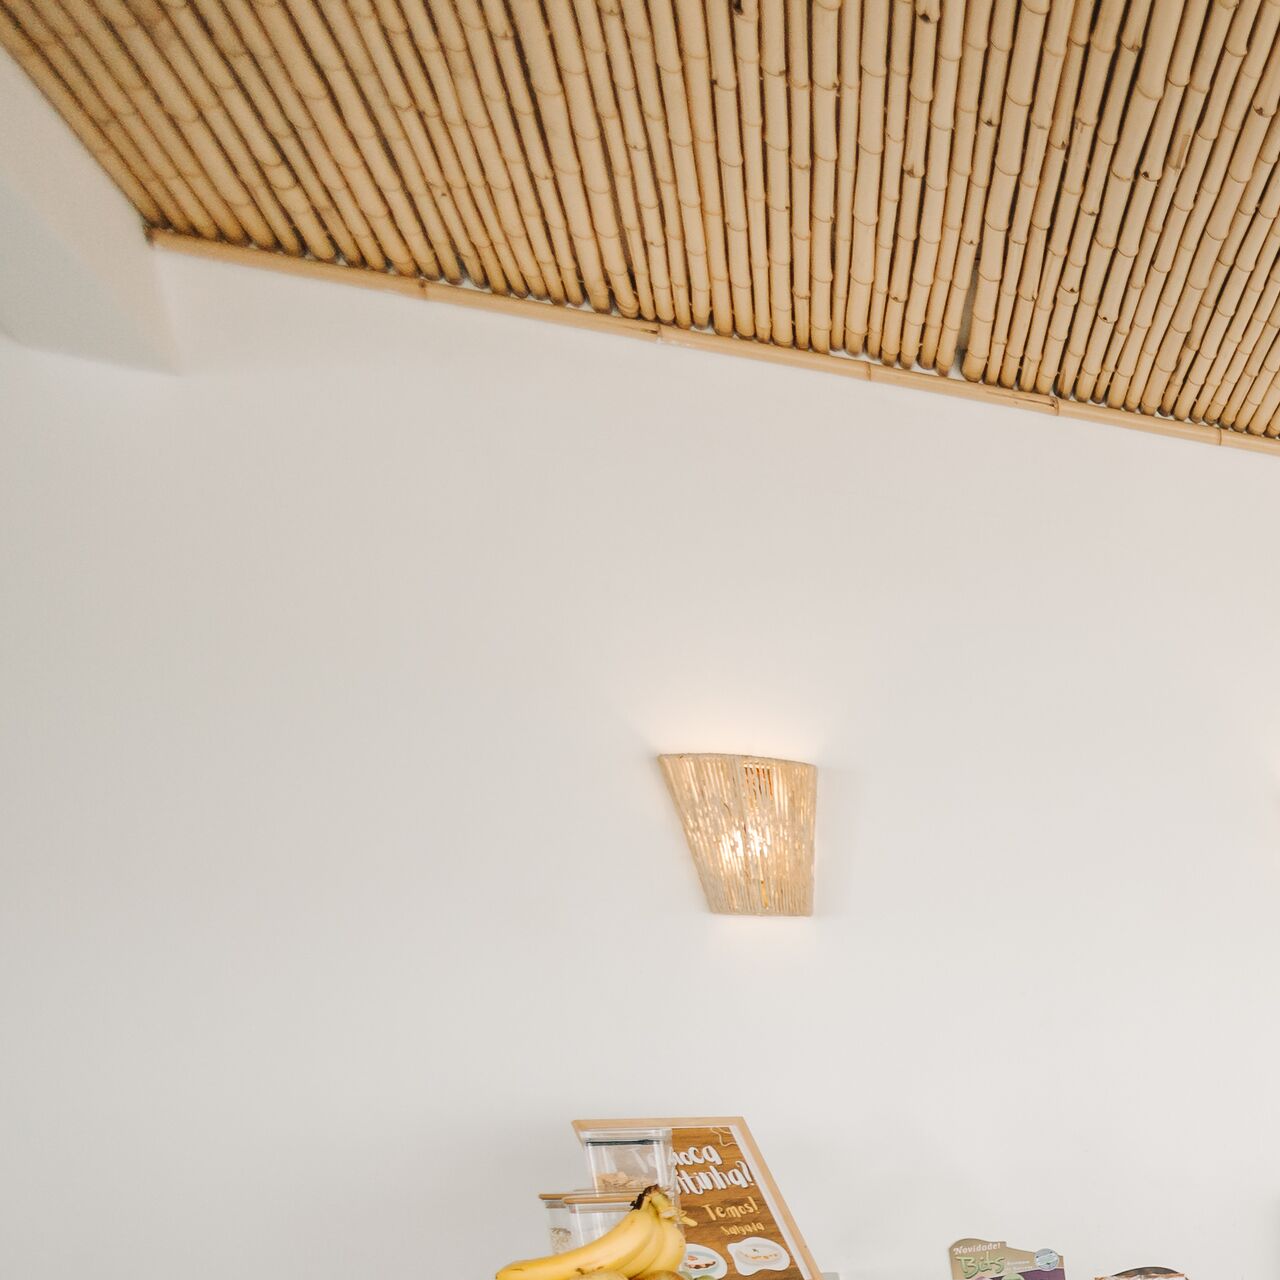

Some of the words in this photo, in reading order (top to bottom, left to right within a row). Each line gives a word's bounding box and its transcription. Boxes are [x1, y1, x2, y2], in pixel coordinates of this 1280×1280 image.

[673, 1145, 722, 1165] ioca
[676, 1161, 756, 1195] ntinha?
[702, 1196, 760, 1221] Temos!
[953, 1242, 1001, 1255] Novidade!
[955, 1250, 1005, 1279] Bits
